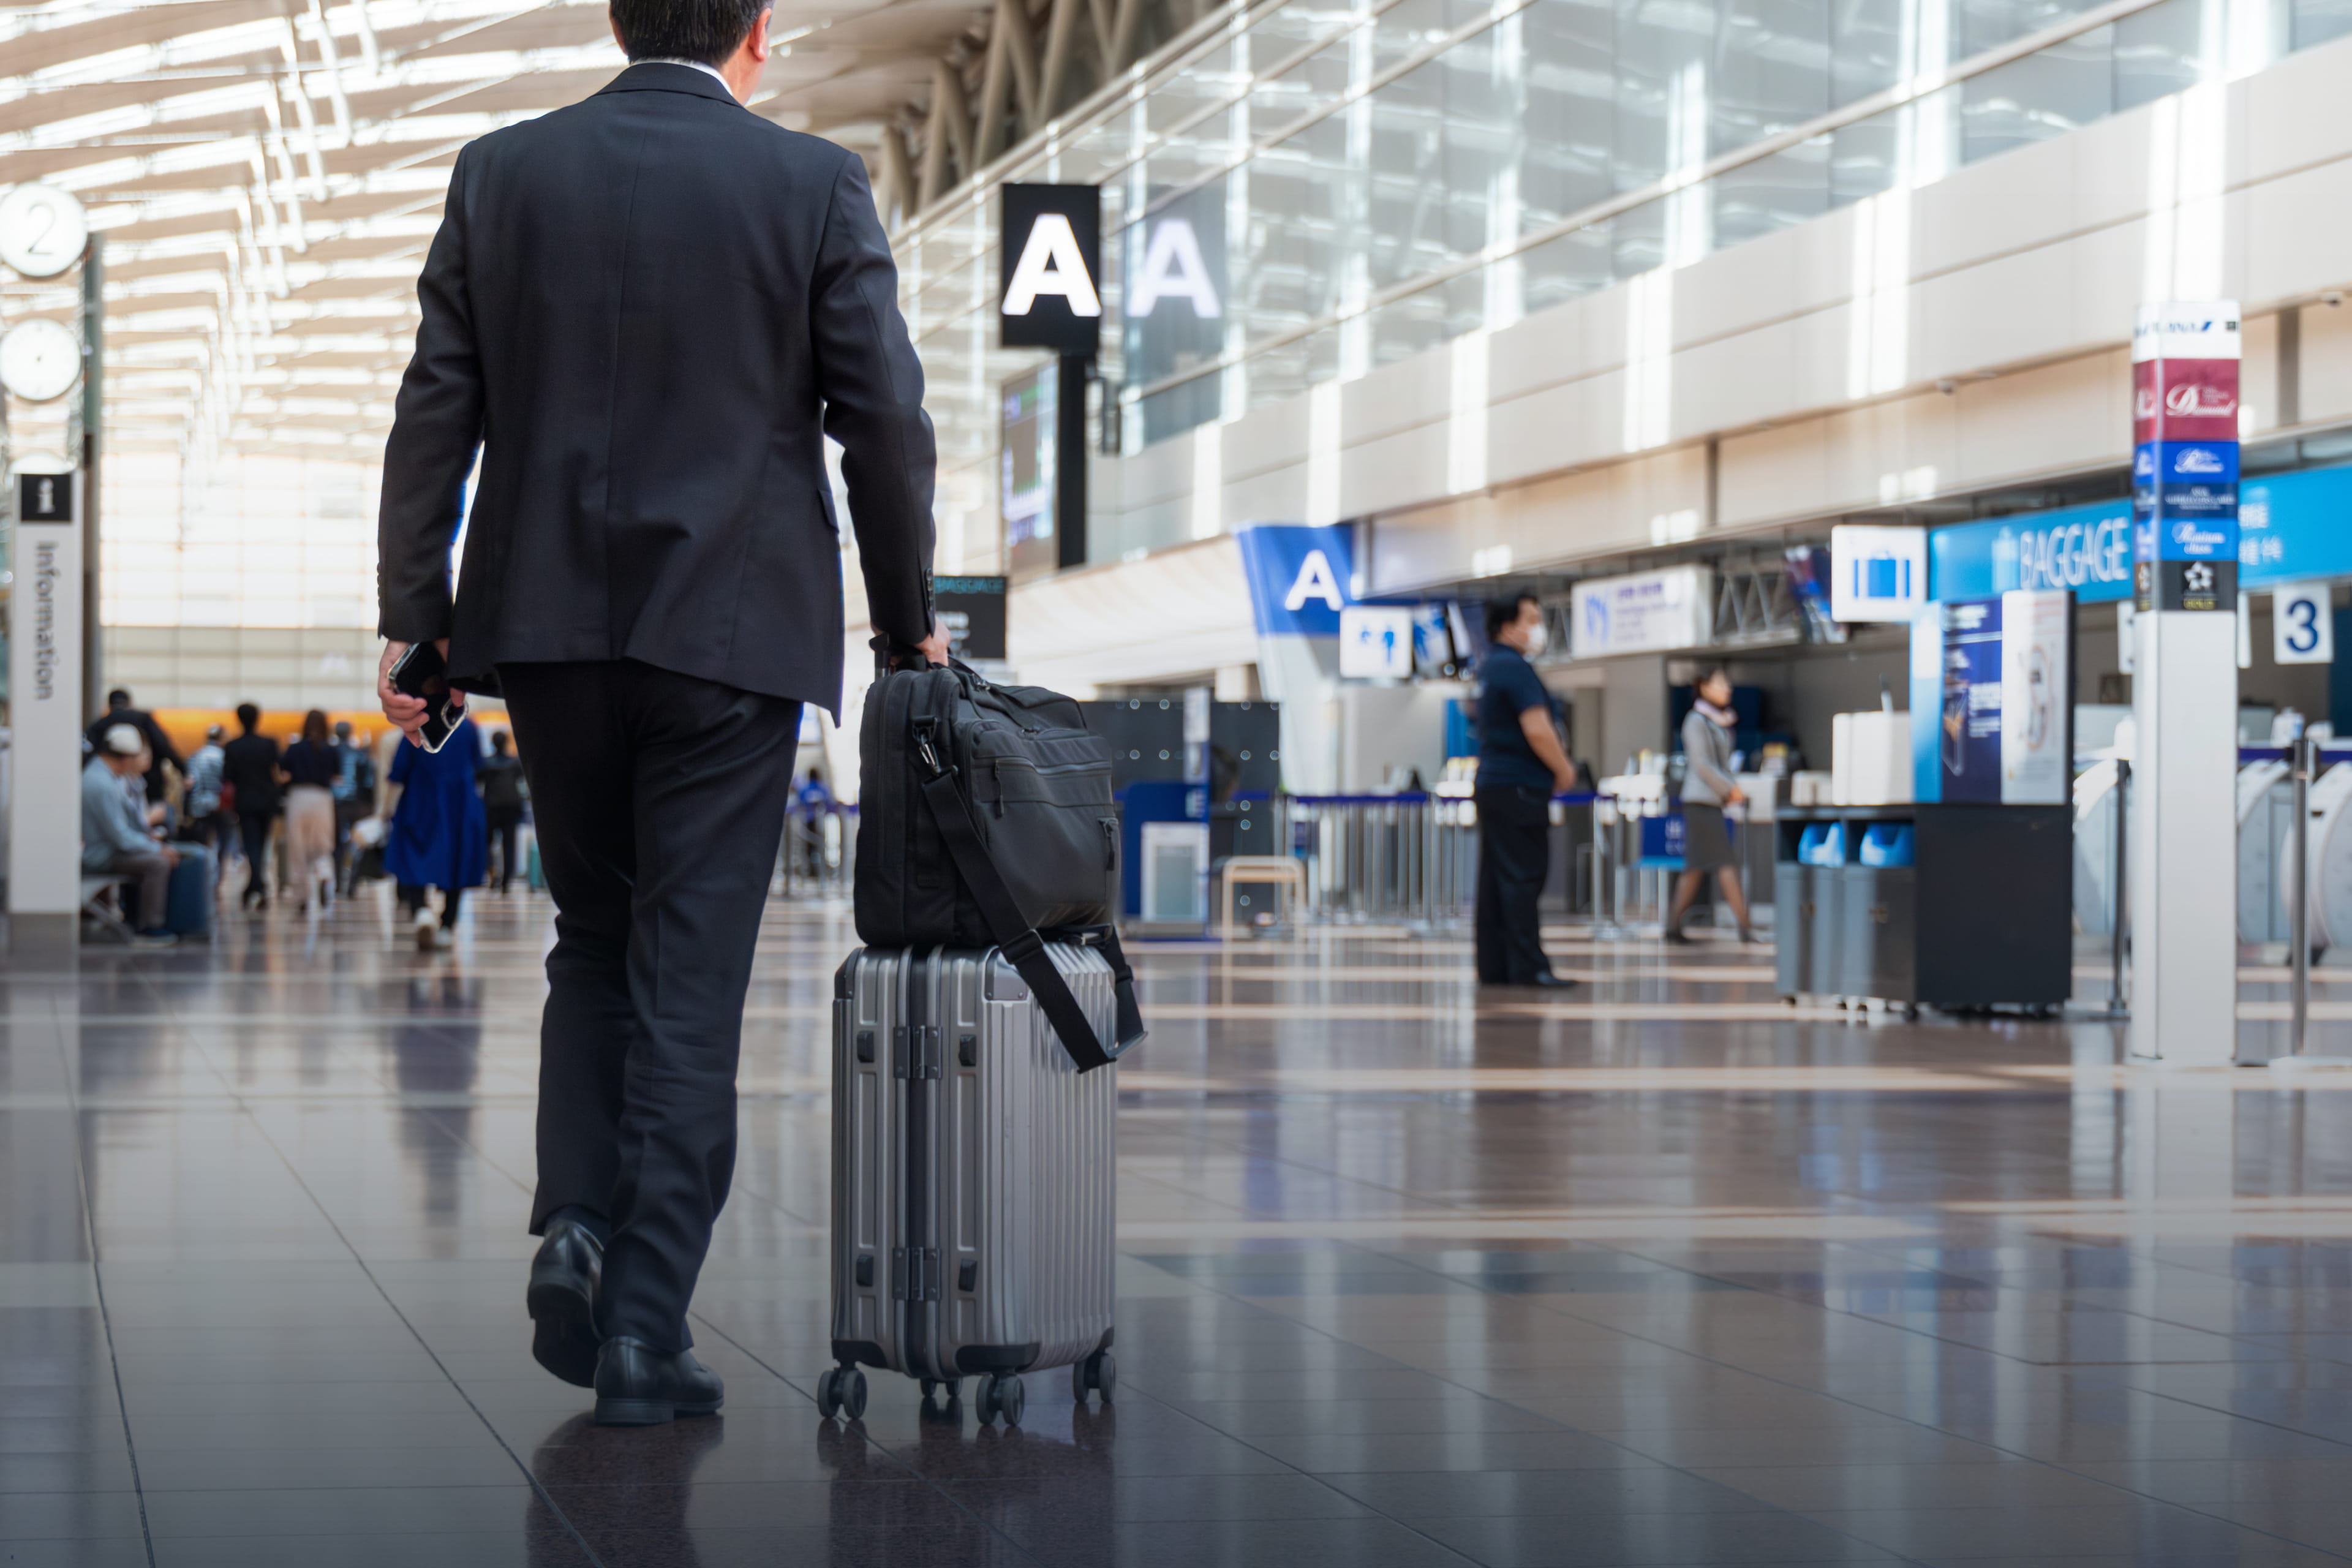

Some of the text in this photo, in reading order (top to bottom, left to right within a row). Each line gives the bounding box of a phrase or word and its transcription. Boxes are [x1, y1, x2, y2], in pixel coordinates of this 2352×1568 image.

[27, 201, 56, 255] 2
[1001, 214, 1101, 317] A
[1125, 219, 1222, 318] A
[1285, 549, 1343, 611] A
[2020, 516, 2129, 589] BAGGAGE
[36, 541, 60, 699] Information
[2286, 598, 2318, 652] 3
